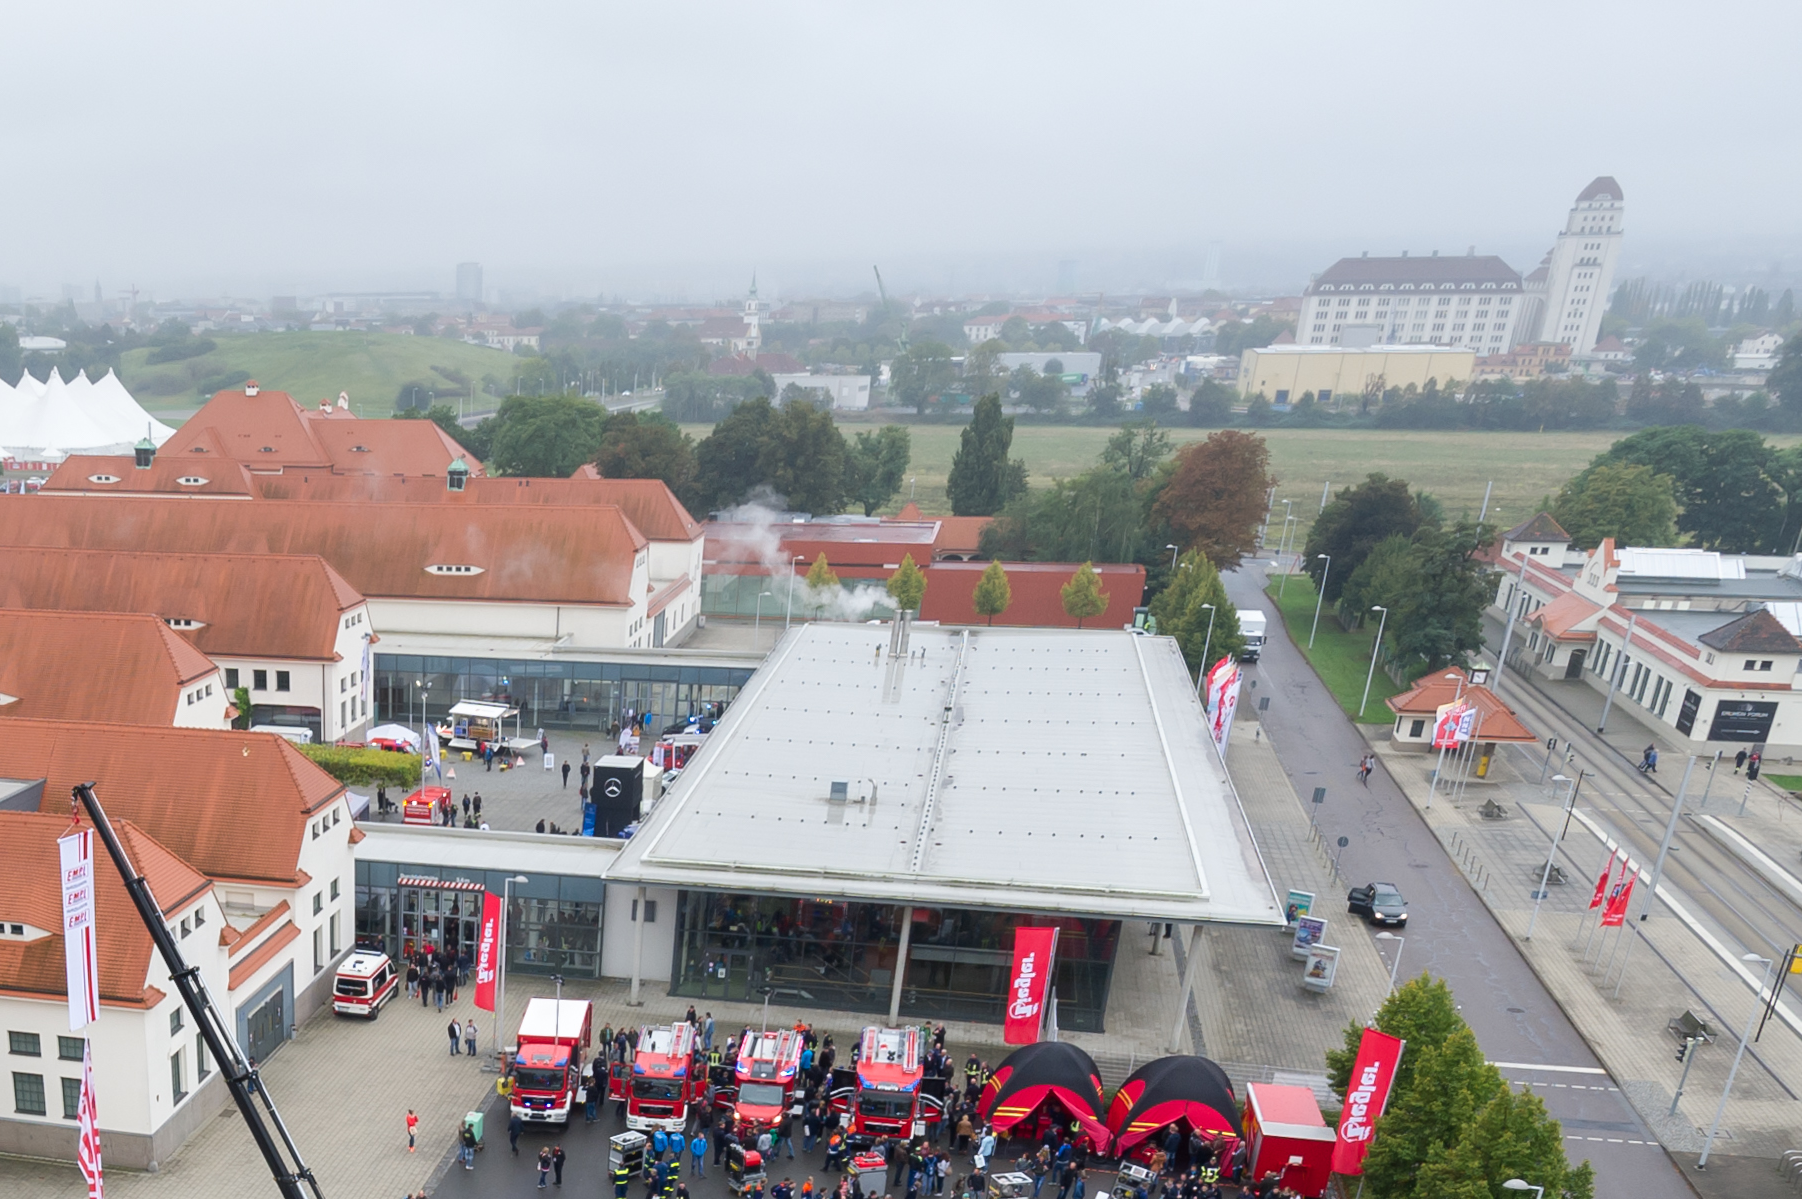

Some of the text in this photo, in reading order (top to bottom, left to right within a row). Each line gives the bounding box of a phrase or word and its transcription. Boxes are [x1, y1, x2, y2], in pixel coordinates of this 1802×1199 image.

[67, 866, 86, 881] EMPL
[67, 888, 87, 905] EMPL
[68, 911, 87, 928] EMPL
